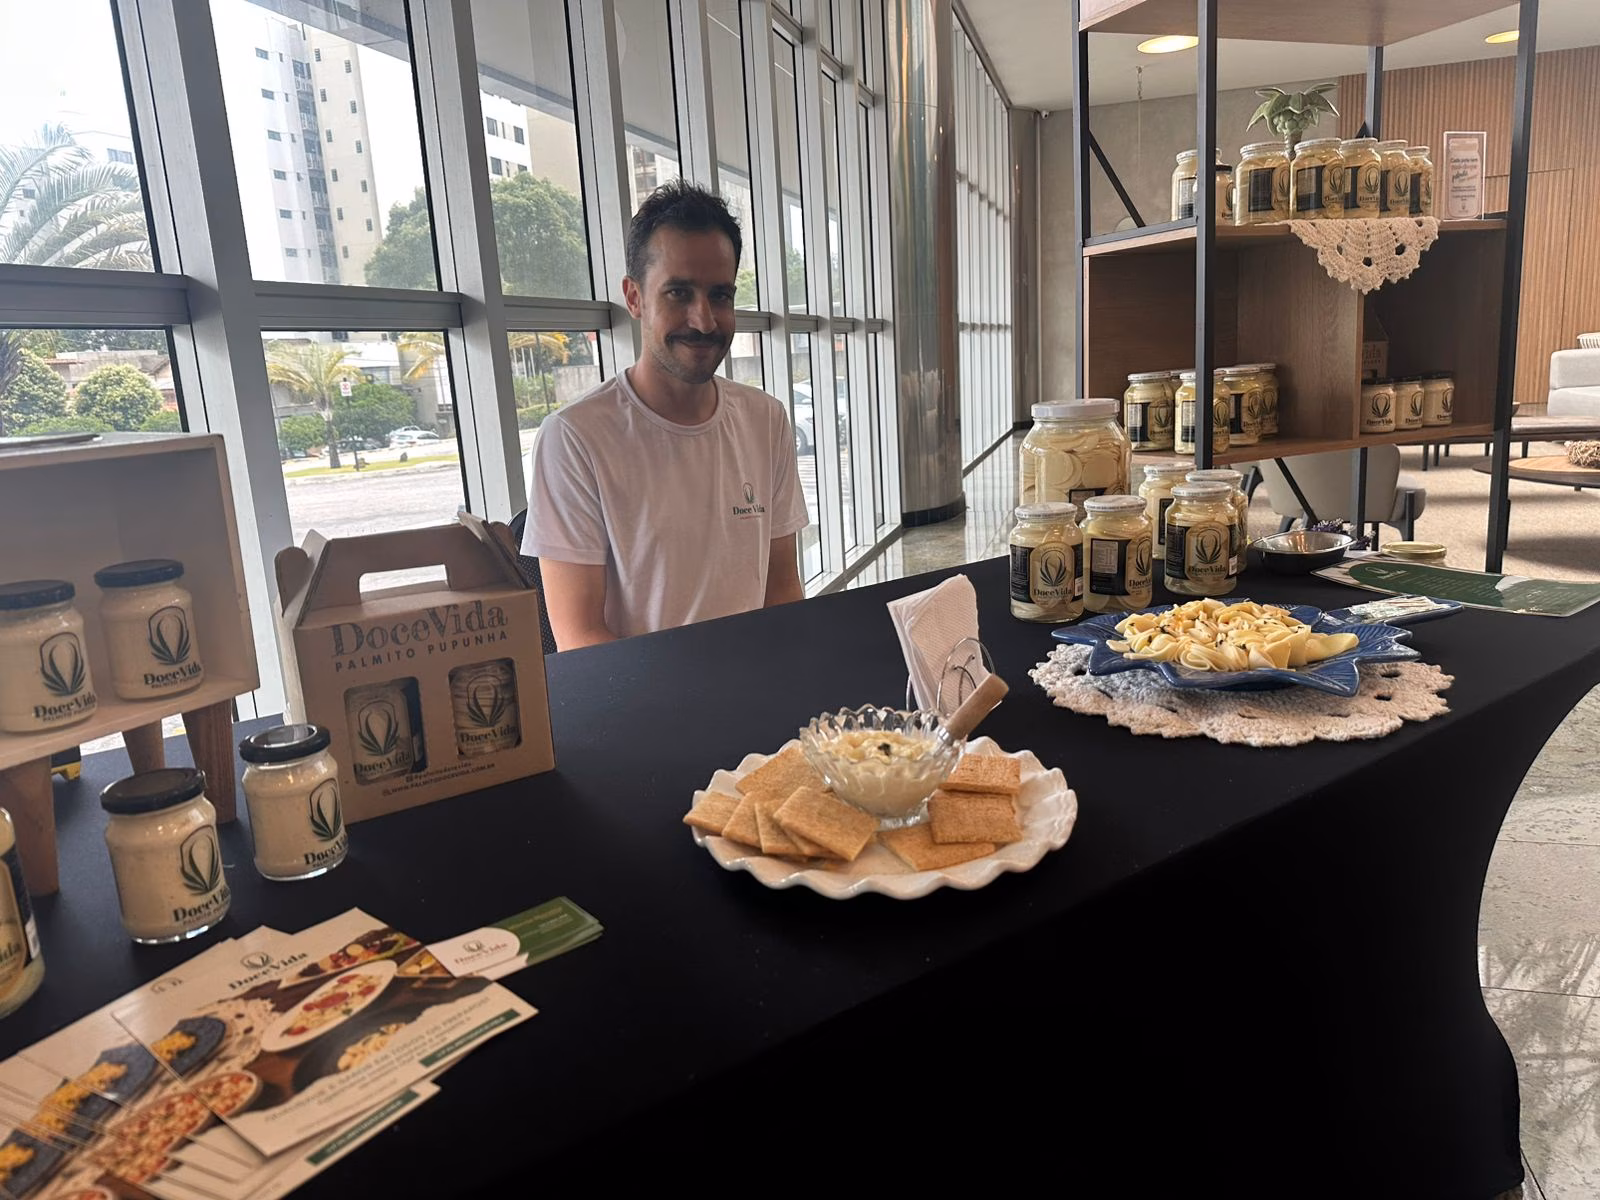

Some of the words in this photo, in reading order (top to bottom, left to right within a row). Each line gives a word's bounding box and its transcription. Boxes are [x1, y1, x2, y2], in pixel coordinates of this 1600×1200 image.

[1033, 587, 1073, 597] DoceVida
[331, 600, 508, 657] DoceVida
[335, 648, 416, 672] PALMITO
[428, 630, 508, 654] PUPUNHA
[143, 662, 202, 686] DoceVida
[34, 693, 96, 720] DoceVida
[460, 723, 519, 744] DoceVida
[353, 750, 411, 775] DoceVida
